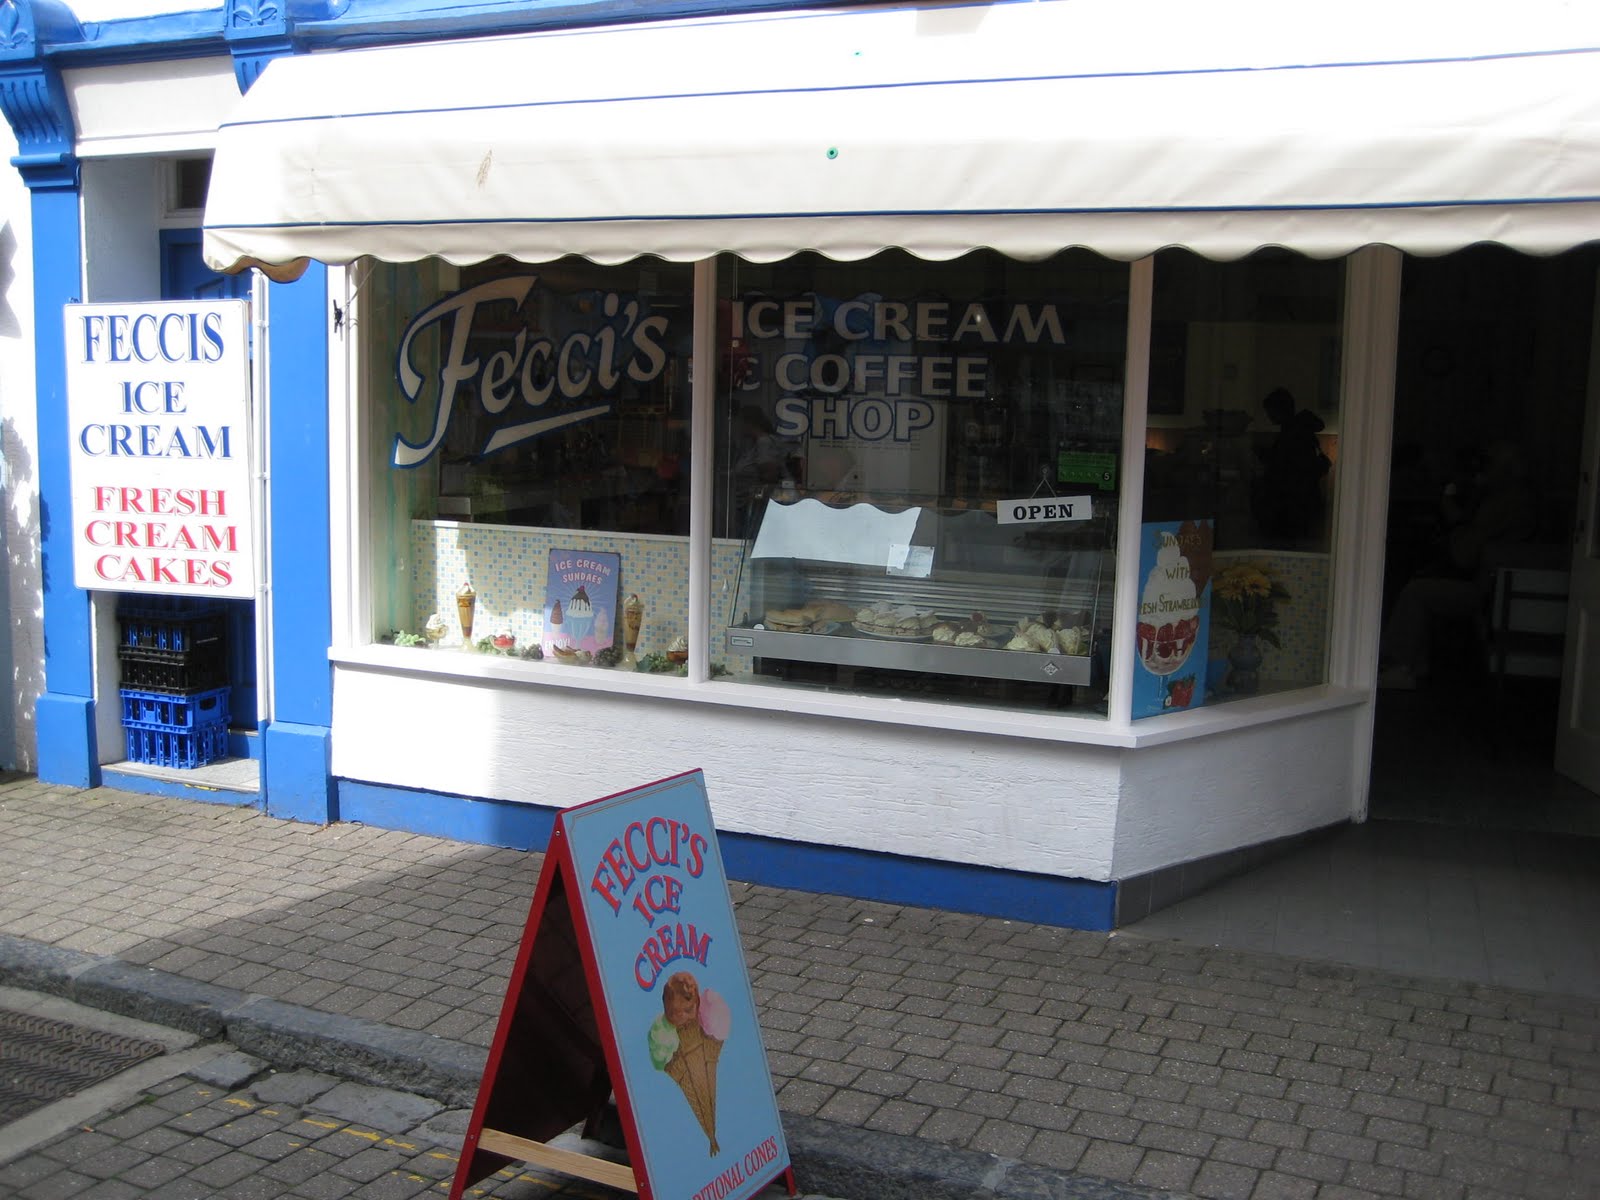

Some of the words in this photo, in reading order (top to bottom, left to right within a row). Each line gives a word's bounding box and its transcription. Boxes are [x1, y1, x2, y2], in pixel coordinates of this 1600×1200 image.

[80, 312, 225, 364] FECCIS
[730, 299, 815, 341] ICE
[832, 299, 1067, 346] CREAM
[391, 273, 670, 469] Fecci's
[773, 352, 990, 398] COFFEE
[120, 380, 187, 415] ICE
[774, 397, 935, 442] SHOP
[79, 423, 232, 460] CREAM
[93, 485, 228, 517] FRESH
[1013, 503, 1074, 521] OPEN
[84, 519, 239, 553] CREAM
[94, 554, 233, 588] CAKES
[555, 560, 573, 572] ICE
[576, 559, 611, 576] CREAM
[562, 572, 603, 585] SUNDAES
[590, 816, 708, 918] FECCI'S
[632, 874, 684, 928] ICE
[634, 922, 713, 993] CREAM
[743, 1135, 779, 1178] CONES
